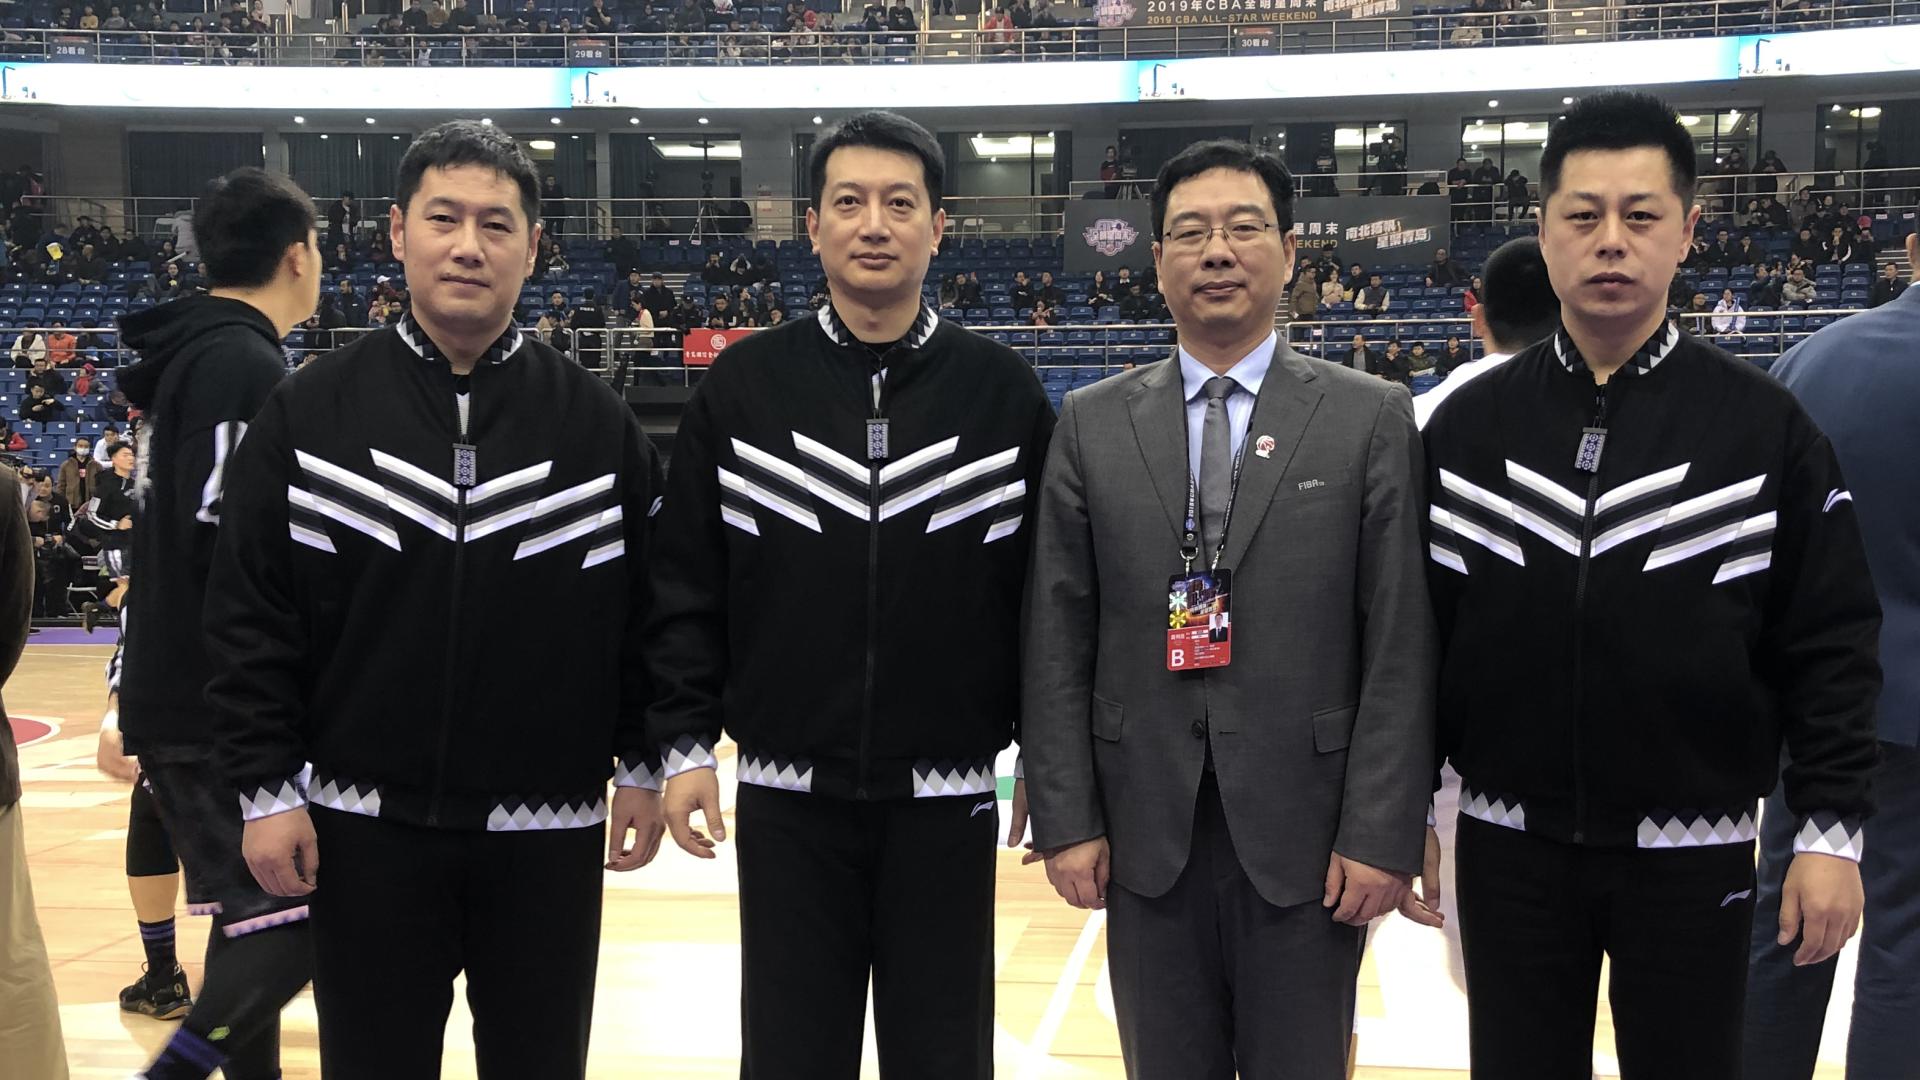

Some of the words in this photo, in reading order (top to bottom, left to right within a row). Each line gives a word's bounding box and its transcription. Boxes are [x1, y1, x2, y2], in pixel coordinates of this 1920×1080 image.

[1147, 15, 1172, 24] 2019
[1175, 15, 1198, 24] CBA
[1201, 13, 1258, 23] ALL-STAR
[1262, 11, 1317, 21] WEEKEND
[1298, 479, 1318, 491] FIBA
[1171, 648, 1185, 667] B
